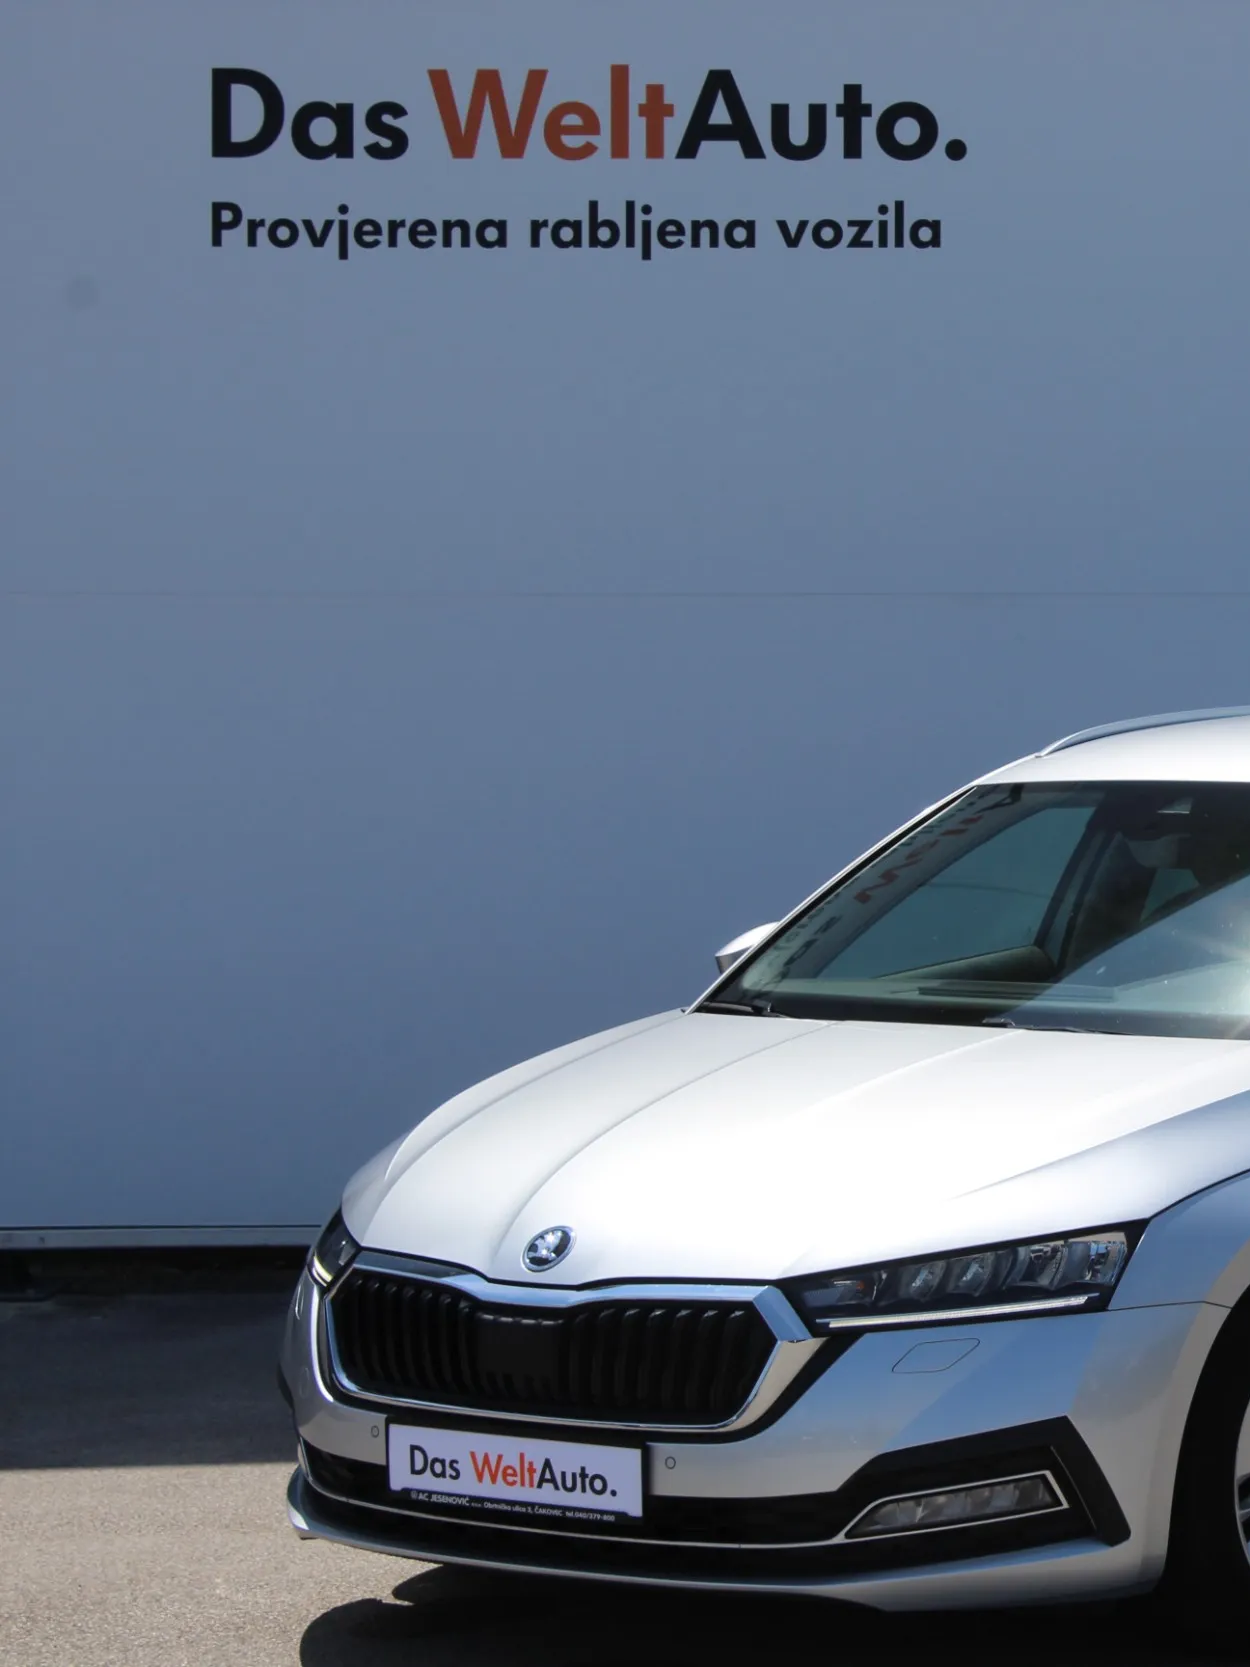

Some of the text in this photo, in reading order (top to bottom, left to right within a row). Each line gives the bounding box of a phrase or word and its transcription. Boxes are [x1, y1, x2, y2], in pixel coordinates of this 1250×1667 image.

[211, 63, 968, 162] Das WeltAuto.
[211, 199, 942, 261] Provjerena rabljena vozila
[409, 1444, 618, 1497] Das WeltAuto.
[430, 1493, 470, 1506] JESENOVIĆ
[534, 1505, 563, 1517] ČAKOVEC
